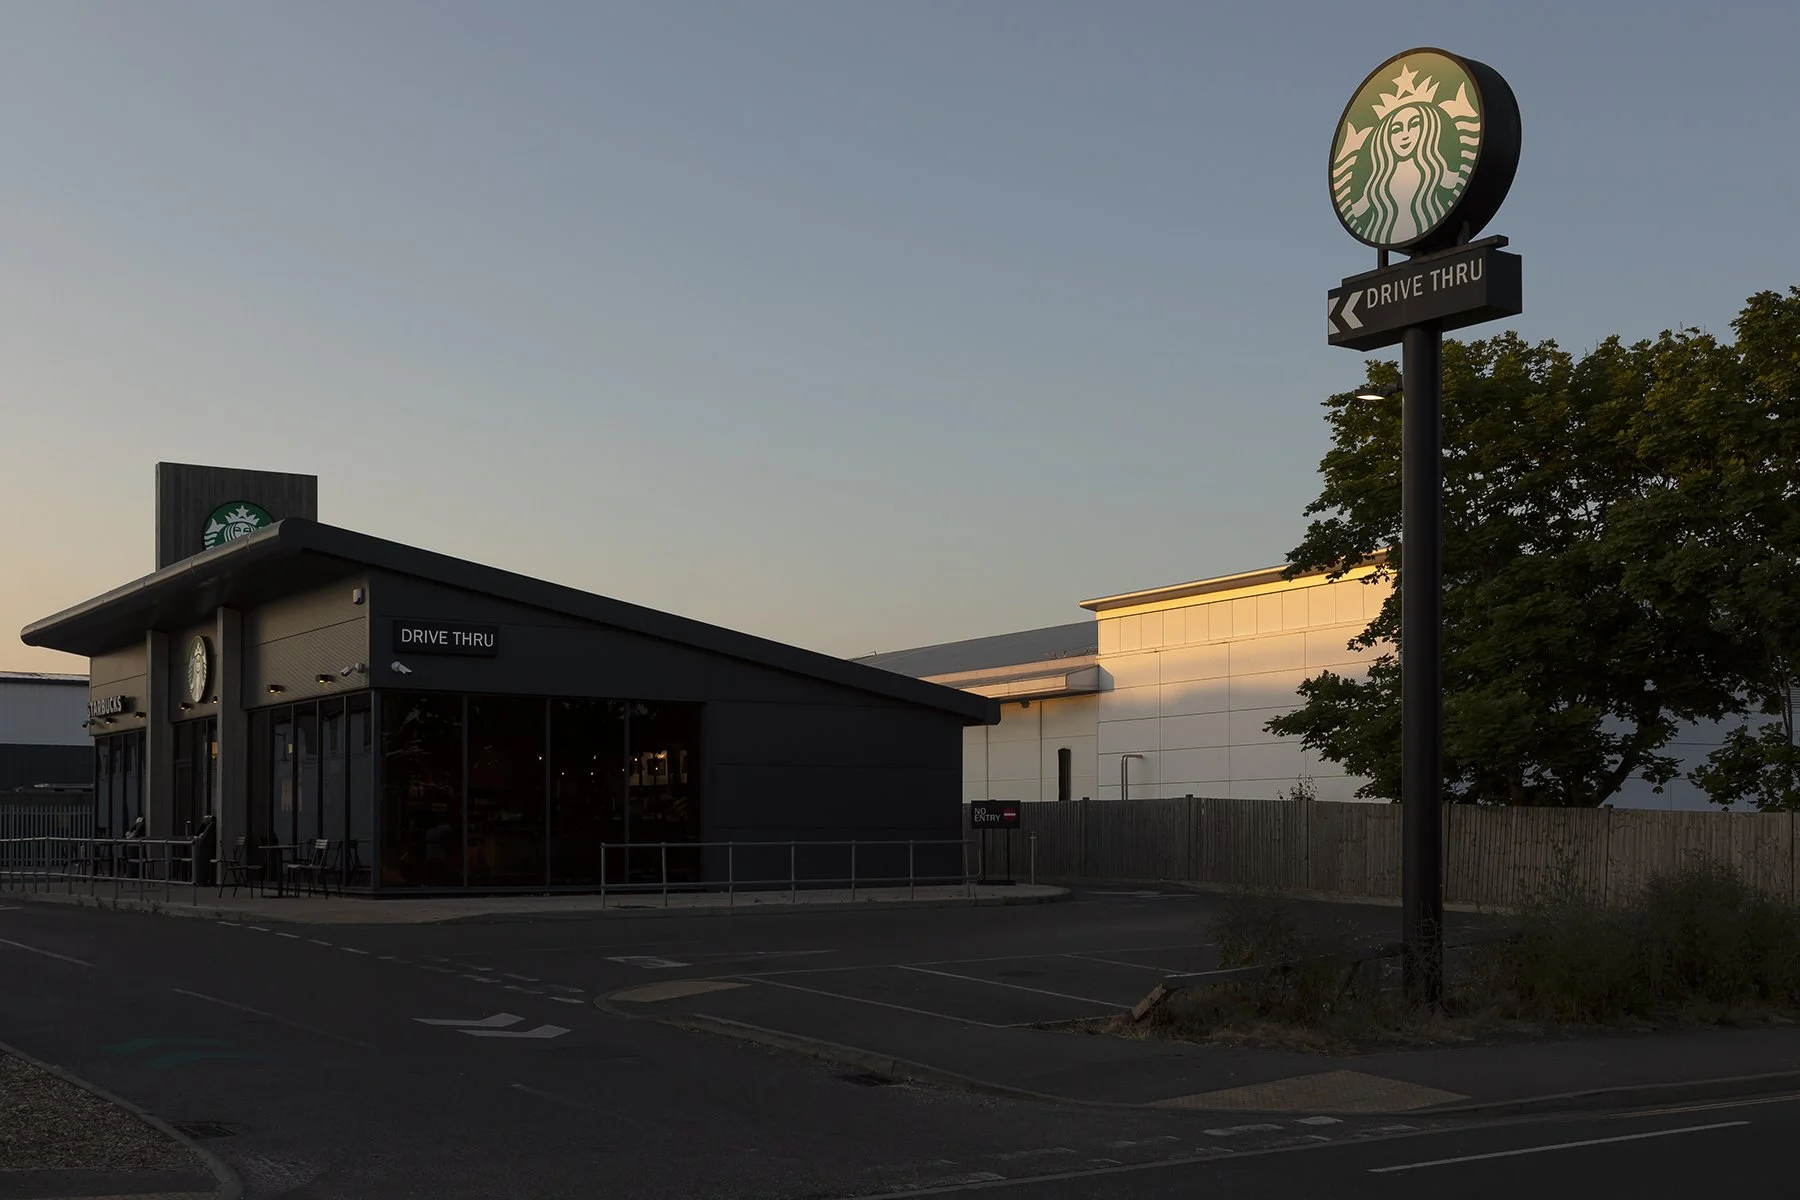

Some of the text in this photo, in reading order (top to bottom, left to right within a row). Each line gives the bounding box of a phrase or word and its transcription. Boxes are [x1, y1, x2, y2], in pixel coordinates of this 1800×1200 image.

[1366, 257, 1485, 309] DRIVE THRU
[401, 628, 494, 648] DRIVE THRU
[974, 807, 987, 815] NO
[974, 814, 1001, 822] ENTRY
